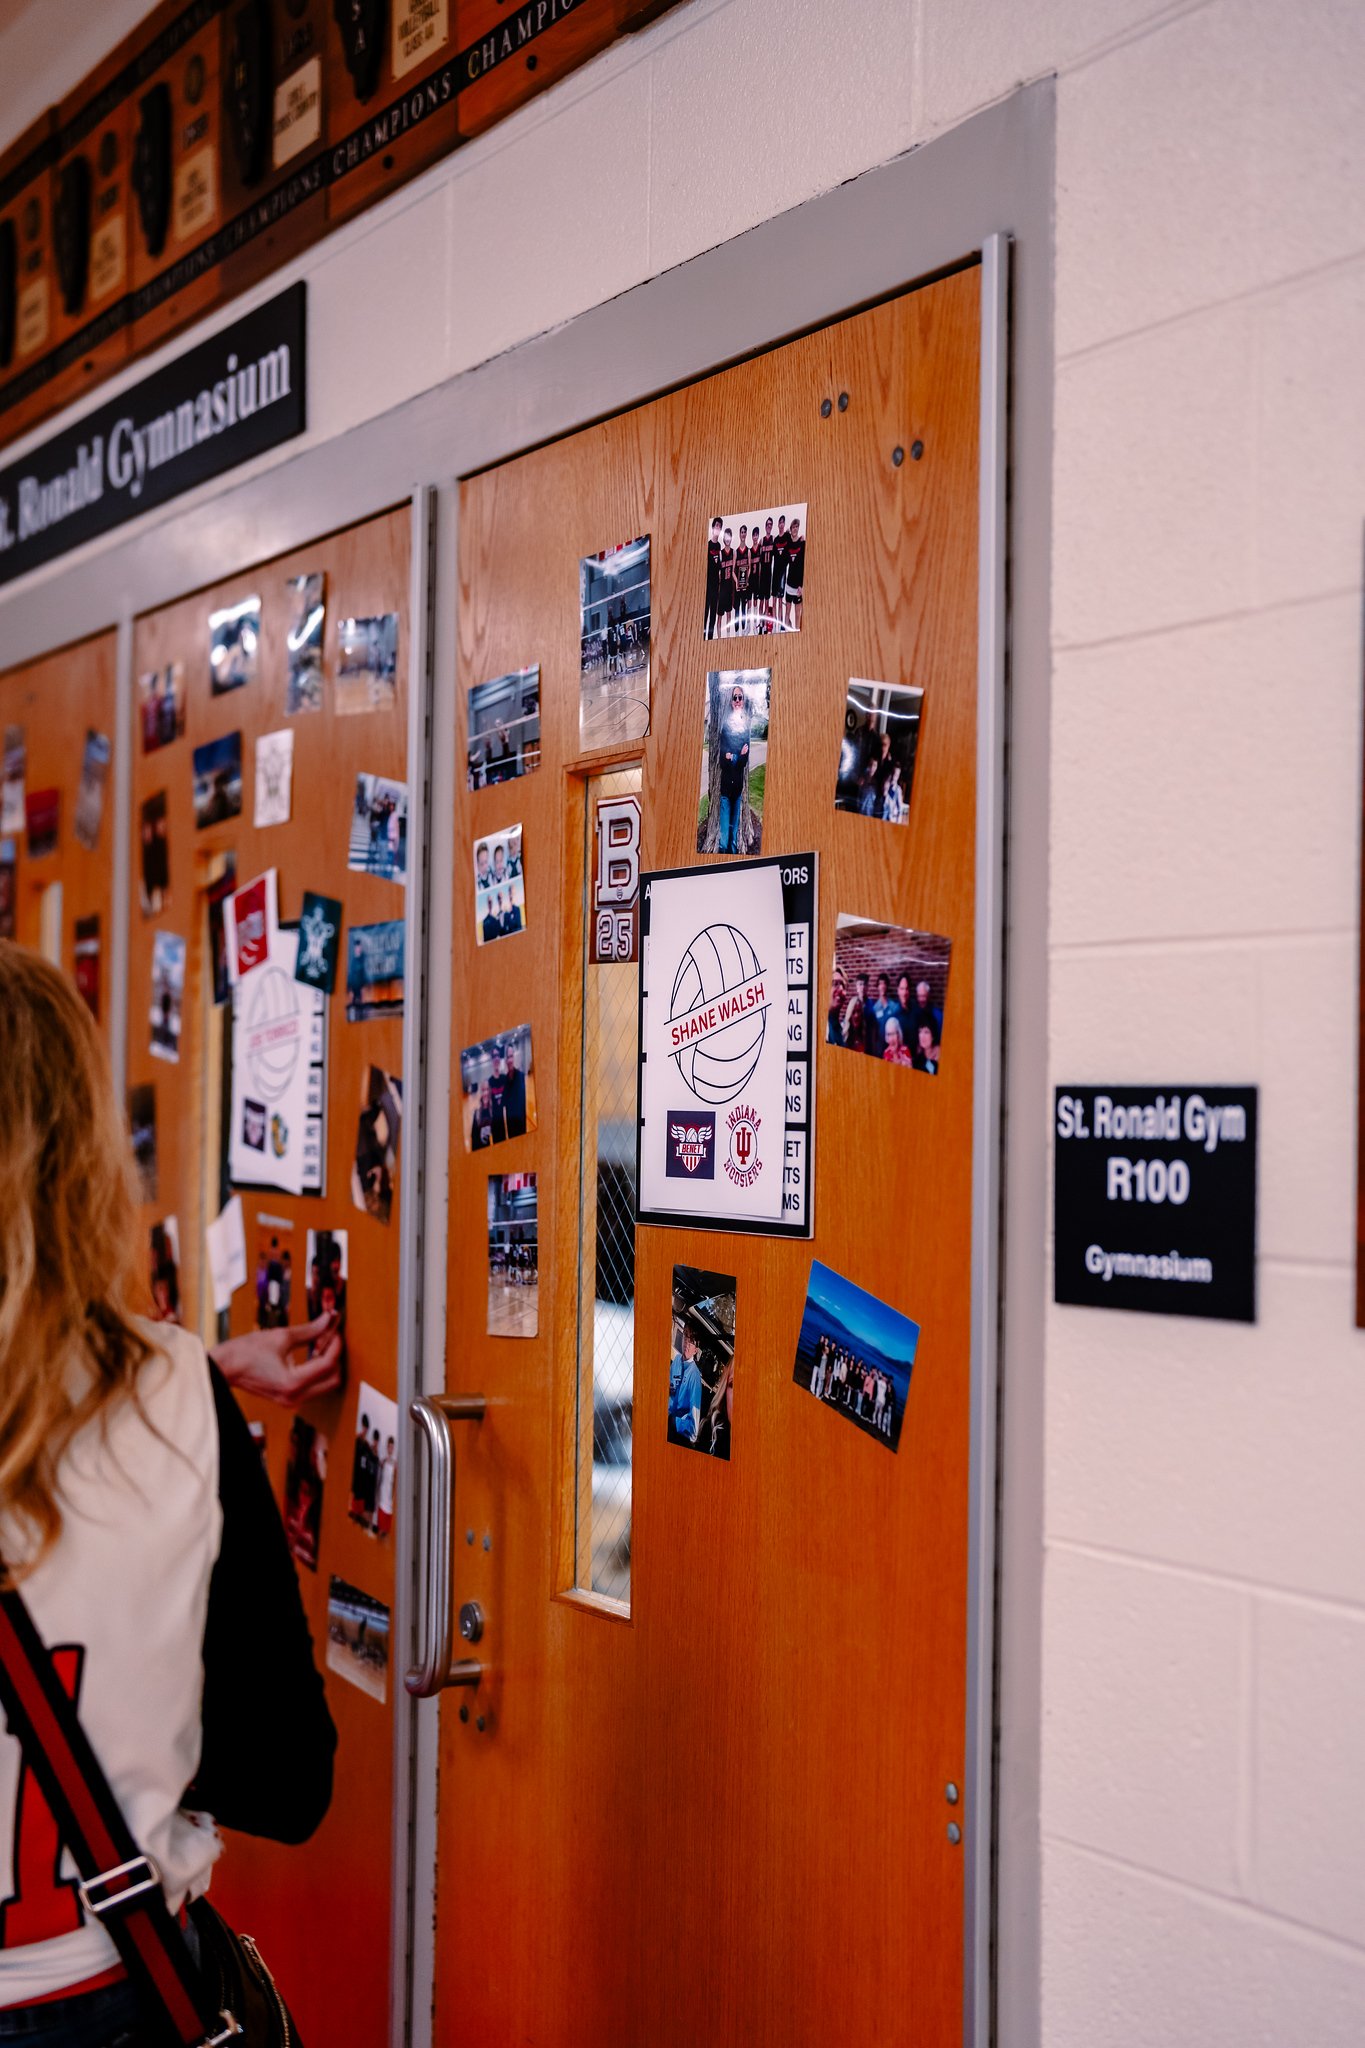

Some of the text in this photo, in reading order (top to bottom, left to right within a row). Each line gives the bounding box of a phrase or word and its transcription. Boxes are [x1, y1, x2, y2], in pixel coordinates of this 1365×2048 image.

[332, 71, 452, 175] CHAMPIONS
[18, 434, 104, 542] Ronald
[106, 343, 291, 498] Gymnasium
[595, 795, 642, 911] B
[780, 866, 808, 885] ORS
[596, 909, 633, 962] 25
[785, 931, 804, 950] ET
[786, 957, 804, 975] TS
[671, 982, 765, 1046] SHANE WALSH
[725, 1104, 762, 1132] INDIANA
[1057, 1094, 1247, 1153] St. Ronald Gym
[681, 1143, 702, 1154] BENET
[784, 1140, 801, 1157] ET
[723, 1158, 763, 1188] HOOSIERS
[783, 1166, 800, 1184] TS
[1107, 1156, 1191, 1206] R100
[1085, 1244, 1213, 1284] Gymnasium
